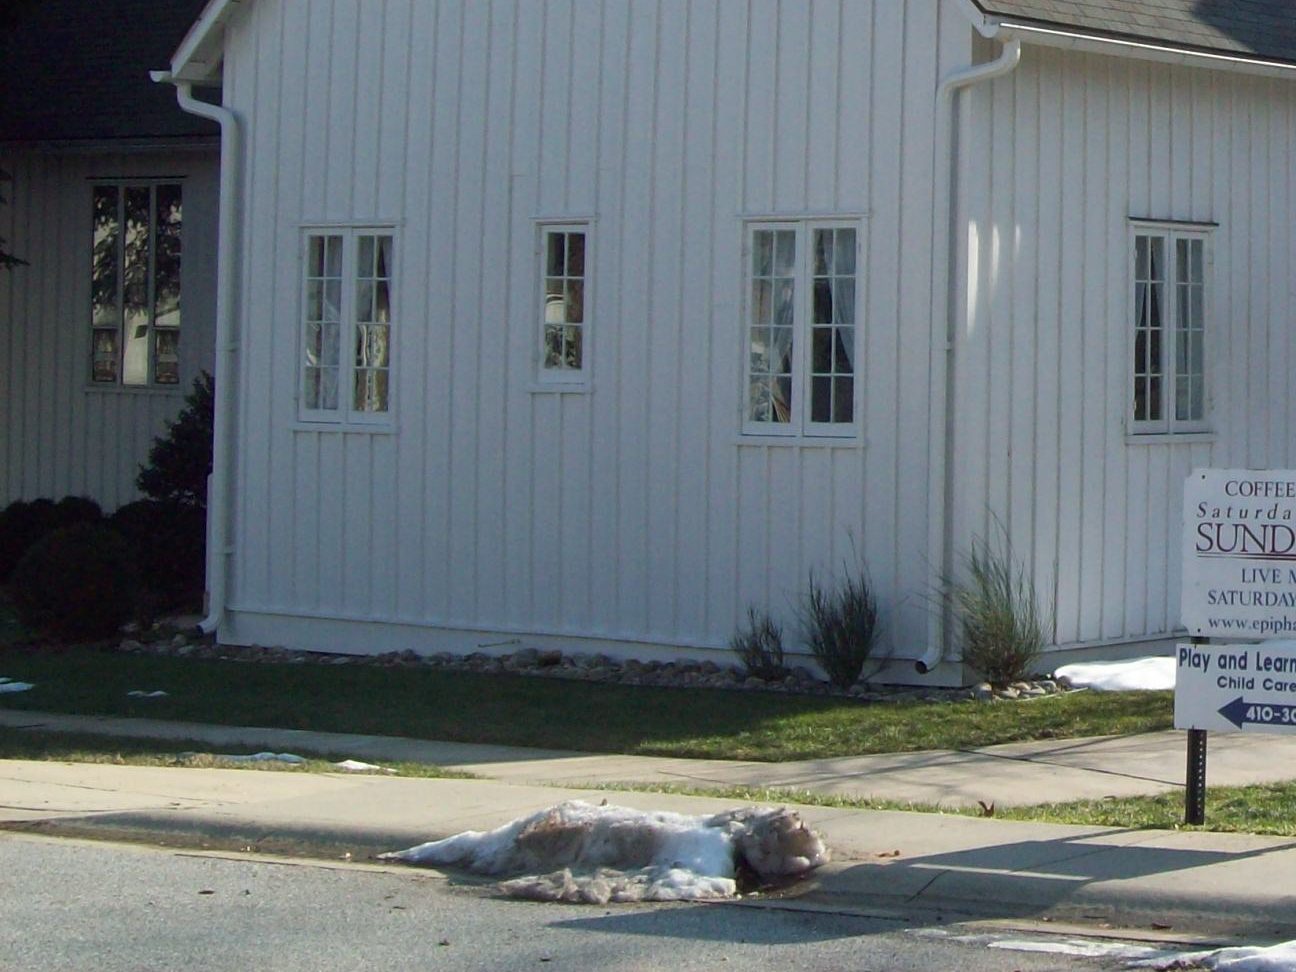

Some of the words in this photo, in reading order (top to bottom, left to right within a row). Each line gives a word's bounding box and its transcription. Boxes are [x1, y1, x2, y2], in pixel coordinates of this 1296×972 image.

[1225, 480, 1295, 497] COFFEE
[1242, 568, 1281, 584] LIVE
[1179, 648, 1210, 673] Play
[1217, 651, 1248, 670] and
[1217, 676, 1254, 690] Child
